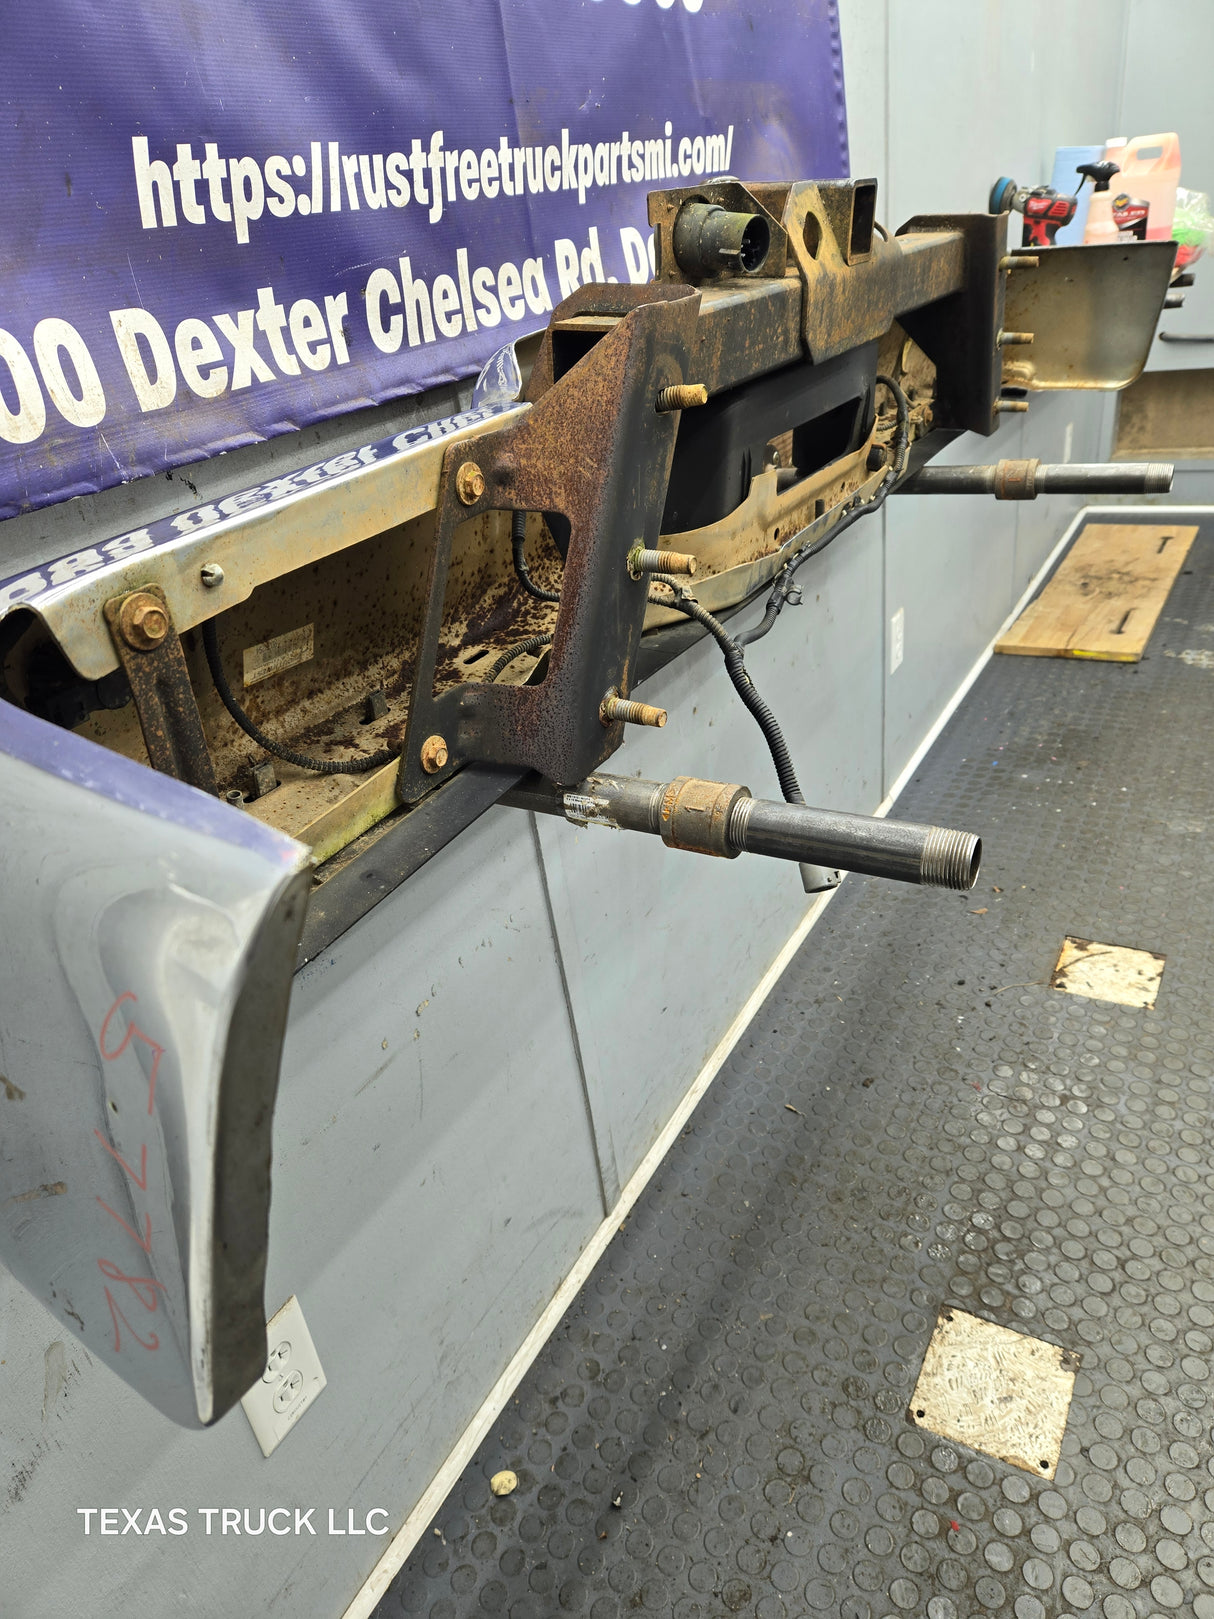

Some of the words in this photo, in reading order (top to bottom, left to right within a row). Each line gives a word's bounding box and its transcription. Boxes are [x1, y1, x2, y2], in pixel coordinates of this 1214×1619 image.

[131, 120, 734, 245] https://rustfreetruckpartsmi.com/
[109, 287, 351, 413] Dexter
[365, 247, 554, 354] Chelsea
